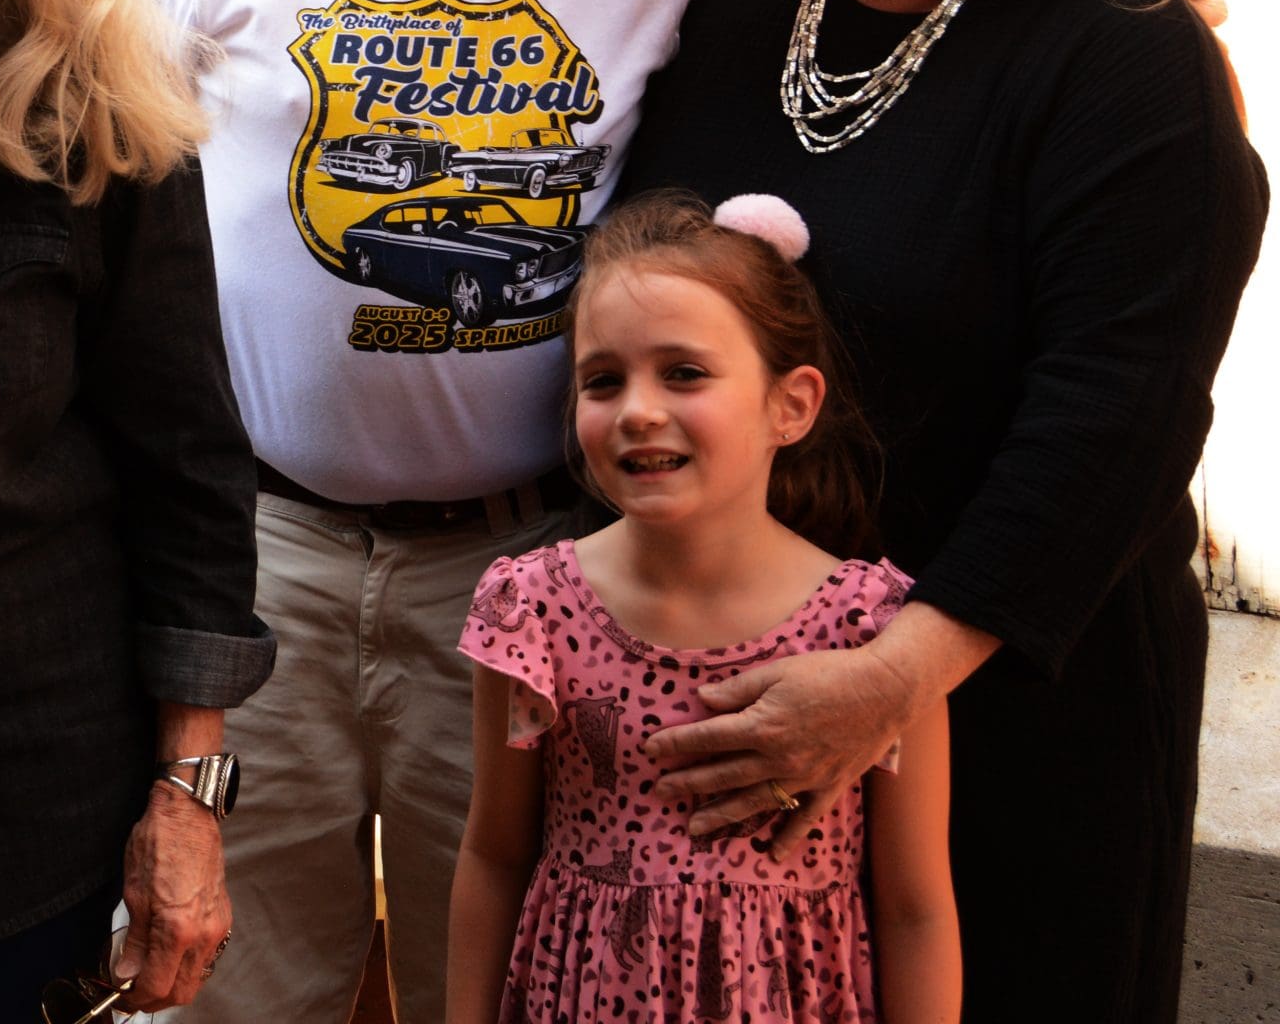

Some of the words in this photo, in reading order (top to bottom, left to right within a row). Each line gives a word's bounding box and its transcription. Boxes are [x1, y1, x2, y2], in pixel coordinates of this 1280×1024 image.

[302, 12, 334, 30] The
[341, 13, 442, 32] Birthplace
[445, 17, 463, 37] of
[330, 34, 478, 68] ROUTE
[491, 34, 546, 67] 66
[354, 66, 596, 122] Festival
[355, 307, 420, 321] AUGUST
[422, 308, 450, 322] 8-9
[350, 323, 447, 347] 2025
